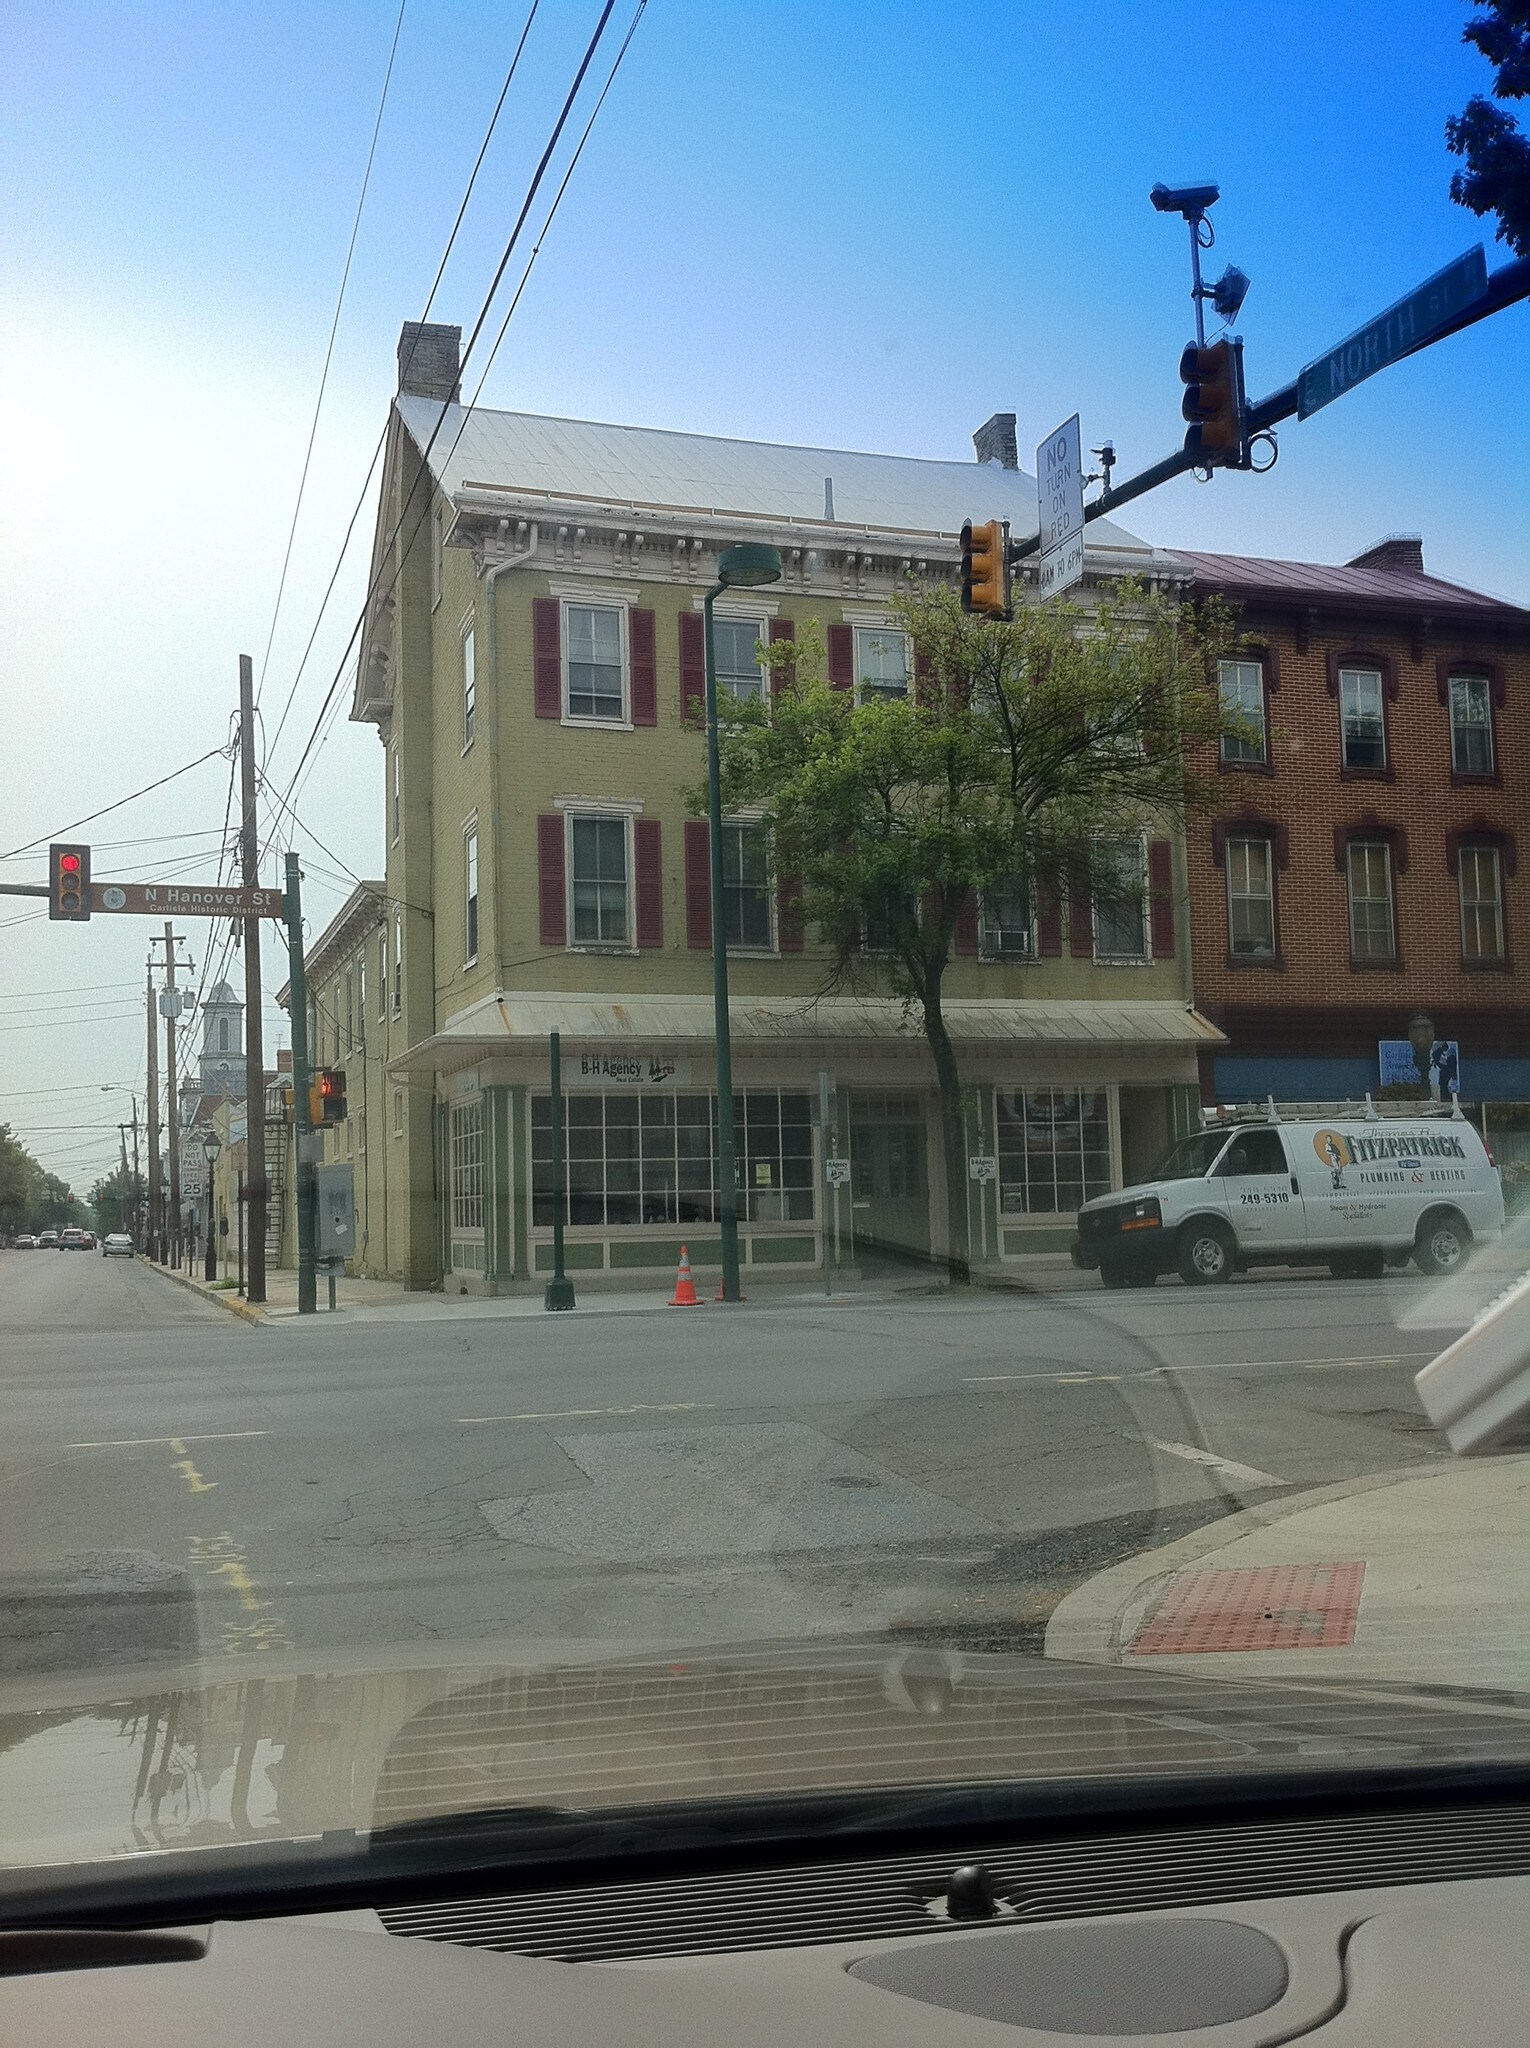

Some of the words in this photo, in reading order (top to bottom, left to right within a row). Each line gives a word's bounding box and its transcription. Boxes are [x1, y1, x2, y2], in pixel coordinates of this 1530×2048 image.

[1330, 304, 1416, 394] NORTH
[1047, 437, 1067, 472] NO
[1047, 462, 1071, 491] TURN
[1052, 490, 1066, 514] ON
[1051, 512, 1070, 540] RED
[1057, 560, 1065, 577] TO
[1067, 546, 1082, 571] 6PM
[145, 888, 157, 901] N
[168, 889, 243, 905] Hanover
[252, 892, 271, 905] St
[150, 904, 186, 913] Carlisle
[191, 905, 228, 914] Historic
[233, 906, 267, 915] District
[581, 1061, 600, 1074] B-H
[602, 1061, 642, 1077] Agency
[1344, 1135, 1466, 1165] FITZPATRICK
[183, 1160, 202, 1168] PASS
[1360, 1171, 1405, 1183] PLUMBING
[1411, 1170, 1424, 1183] &
[1431, 1170, 1466, 1181] HEATING
[183, 1183, 201, 1195] 25
[1240, 1192, 1289, 1205] 249-5310
